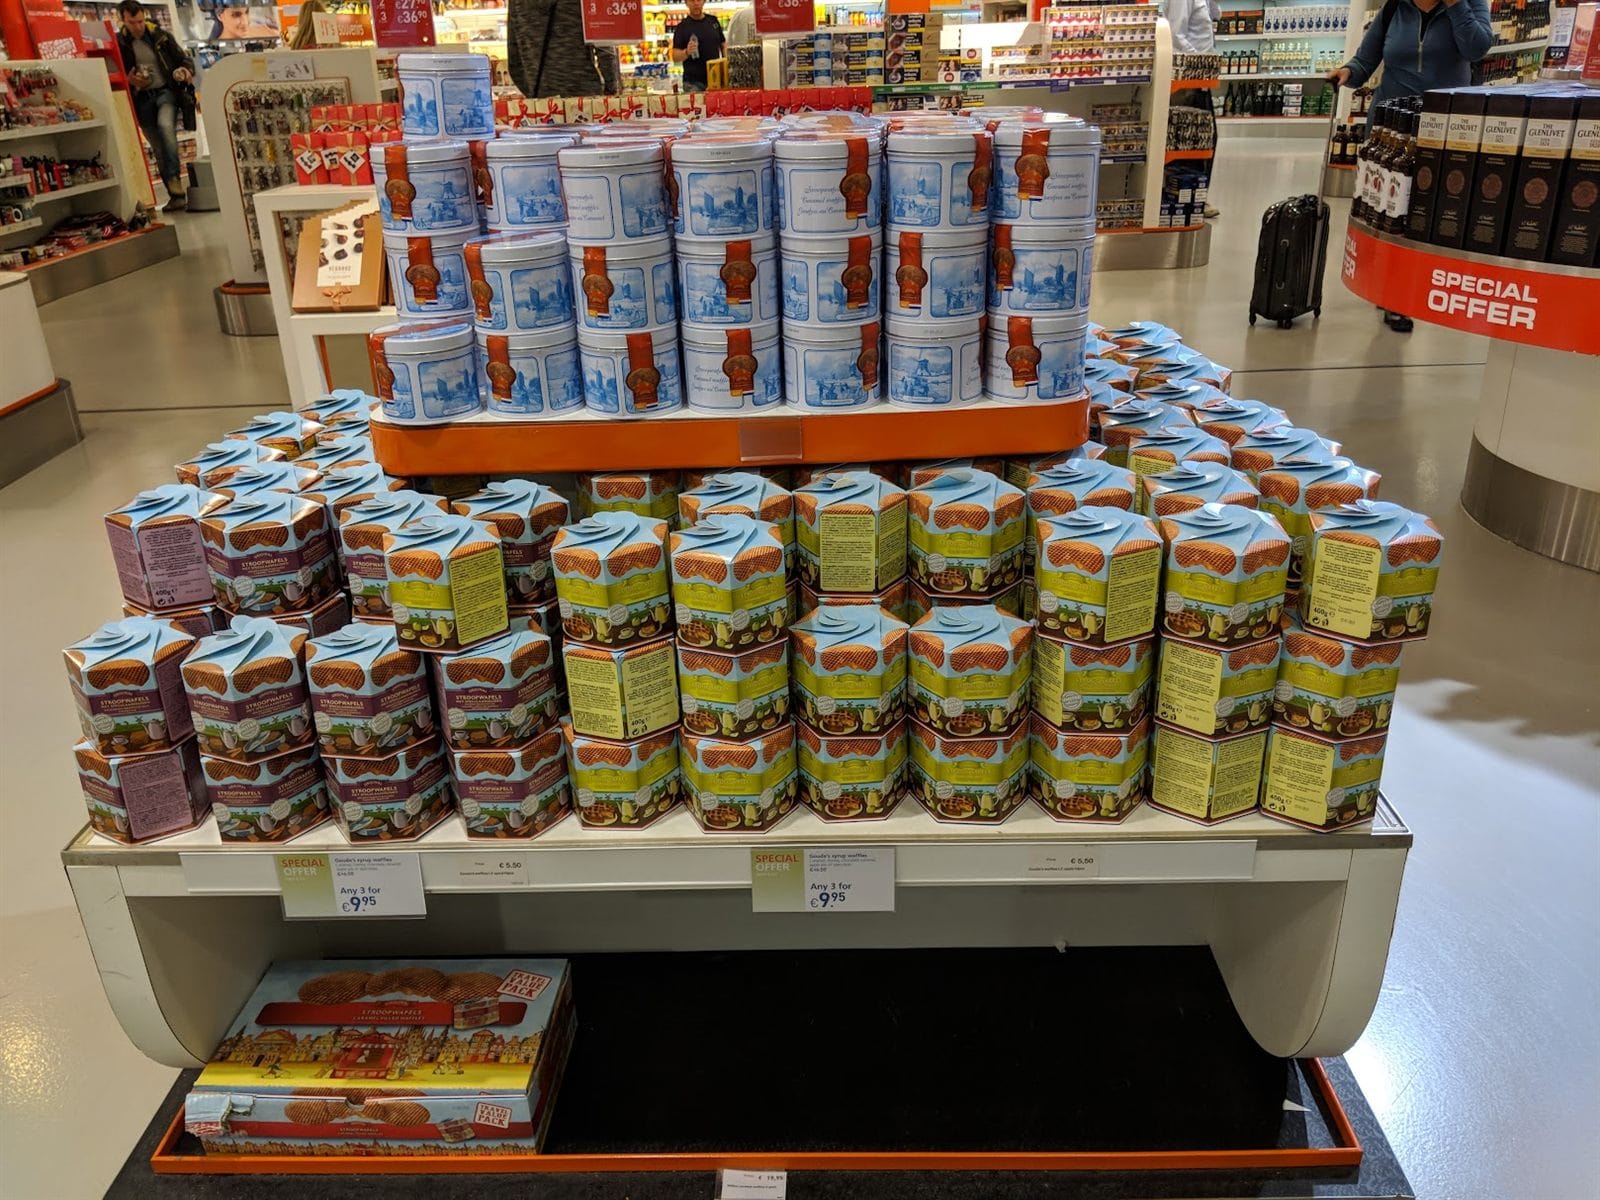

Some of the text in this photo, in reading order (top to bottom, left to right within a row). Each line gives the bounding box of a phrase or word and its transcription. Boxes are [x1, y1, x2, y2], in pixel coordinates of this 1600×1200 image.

[606, 3, 638, 17] €36.90
[381, 10, 428, 24] 3 €36.90
[1485, 125, 1518, 135] GLENLIVET
[1528, 128, 1566, 138] GLENLIVET
[1577, 129, 1600, 138] GLENL
[1431, 268, 1538, 303] SPECIAL
[1428, 289, 1537, 331] OFFER
[241, 557, 288, 568] STROOPWAFELS
[100, 696, 150, 706] STROOPWAFELS
[246, 692, 293, 710] STROOPWAFELS
[320, 698, 364, 706] STROOPWAFELS
[351, 786, 397, 794] STROOPWAFELS
[281, 858, 325, 868] SPECIAL
[755, 854, 799, 863] SPECIAL
[1077, 857, 1094, 865] 5.50
[283, 867, 318, 876] OFFER
[755, 863, 790, 872] OFFER
[340, 887, 358, 896] Any
[368, 886, 382, 894] for
[810, 882, 829, 891] Any
[342, 896, 376, 912] €9.95
[810, 892, 846, 908] €9.95
[512, 971, 546, 984] TRAVEL
[508, 977, 543, 990] VALUE
[501, 983, 538, 998] PACK
[479, 1103, 511, 1114] TRAVEL
[478, 1109, 507, 1120] VALUE
[476, 1115, 507, 1127] PACK
